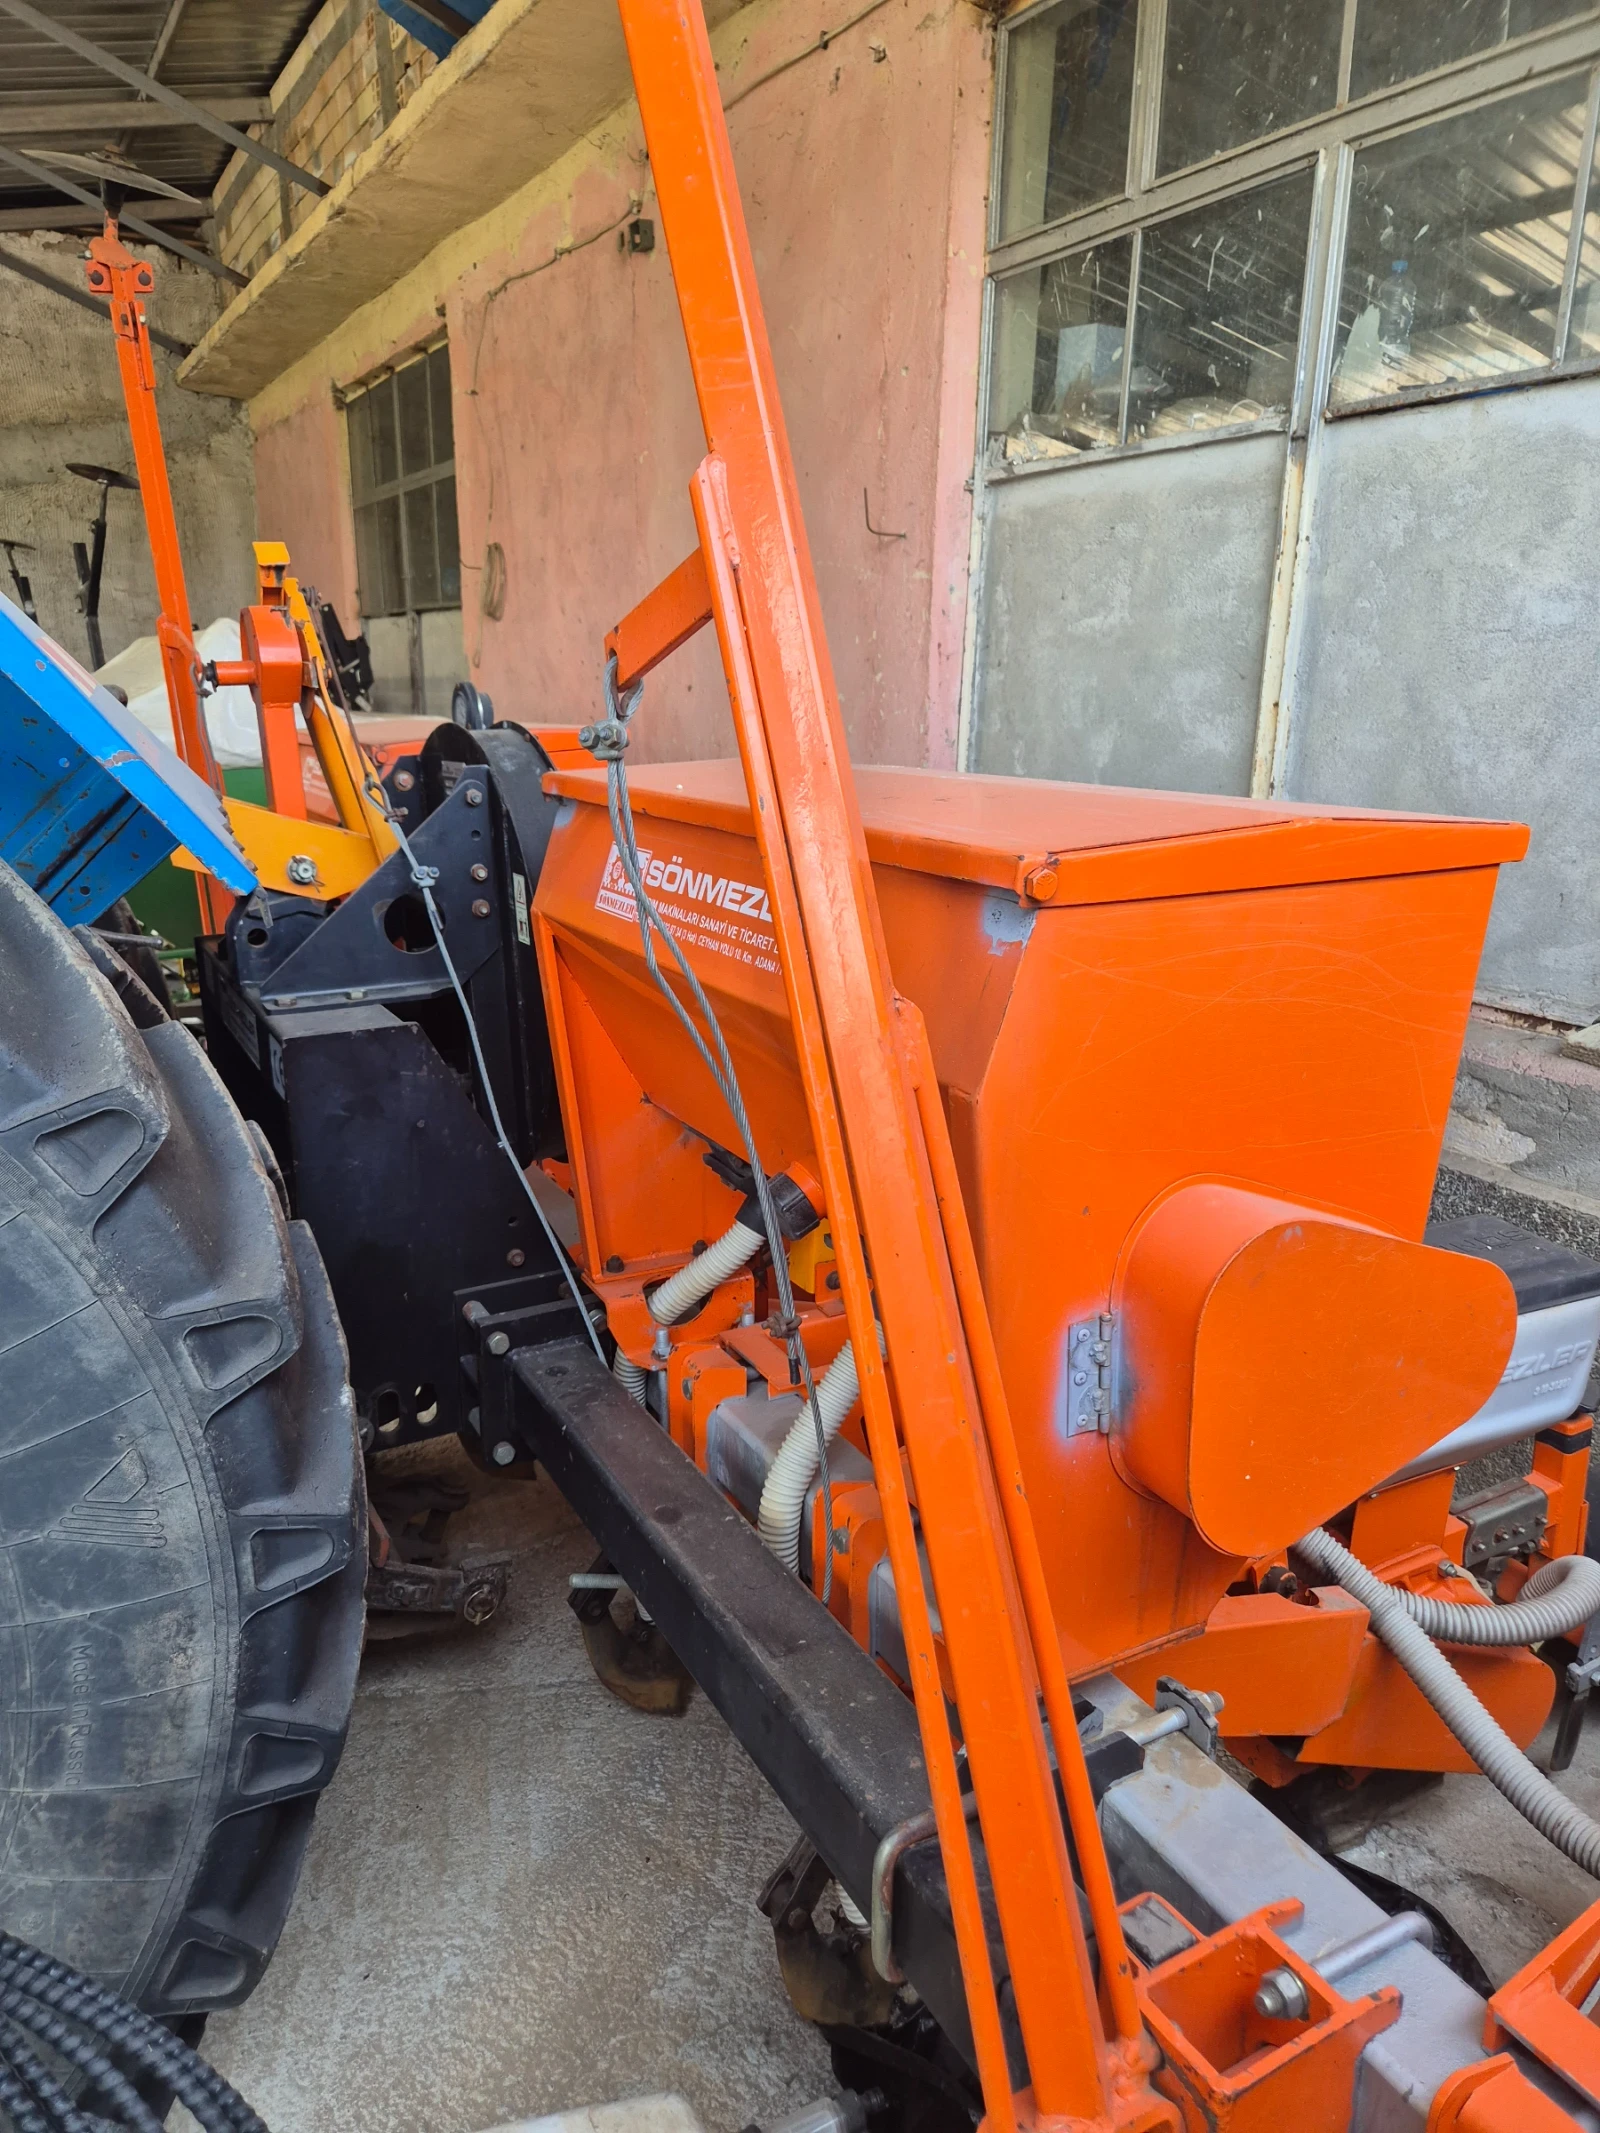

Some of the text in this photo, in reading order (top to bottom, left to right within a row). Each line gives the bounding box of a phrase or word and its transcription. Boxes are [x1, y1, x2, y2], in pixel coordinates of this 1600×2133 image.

[657, 903, 700, 926] MAKİNALARI
[699, 915, 729, 936] SANAYİ
[727, 924, 739, 940] VE
[739, 926, 775, 951] TİCARET
[719, 941, 735, 957] YOLU
[754, 955, 776, 973] ADANA
[65, 1644, 96, 1787] Made in Russia
